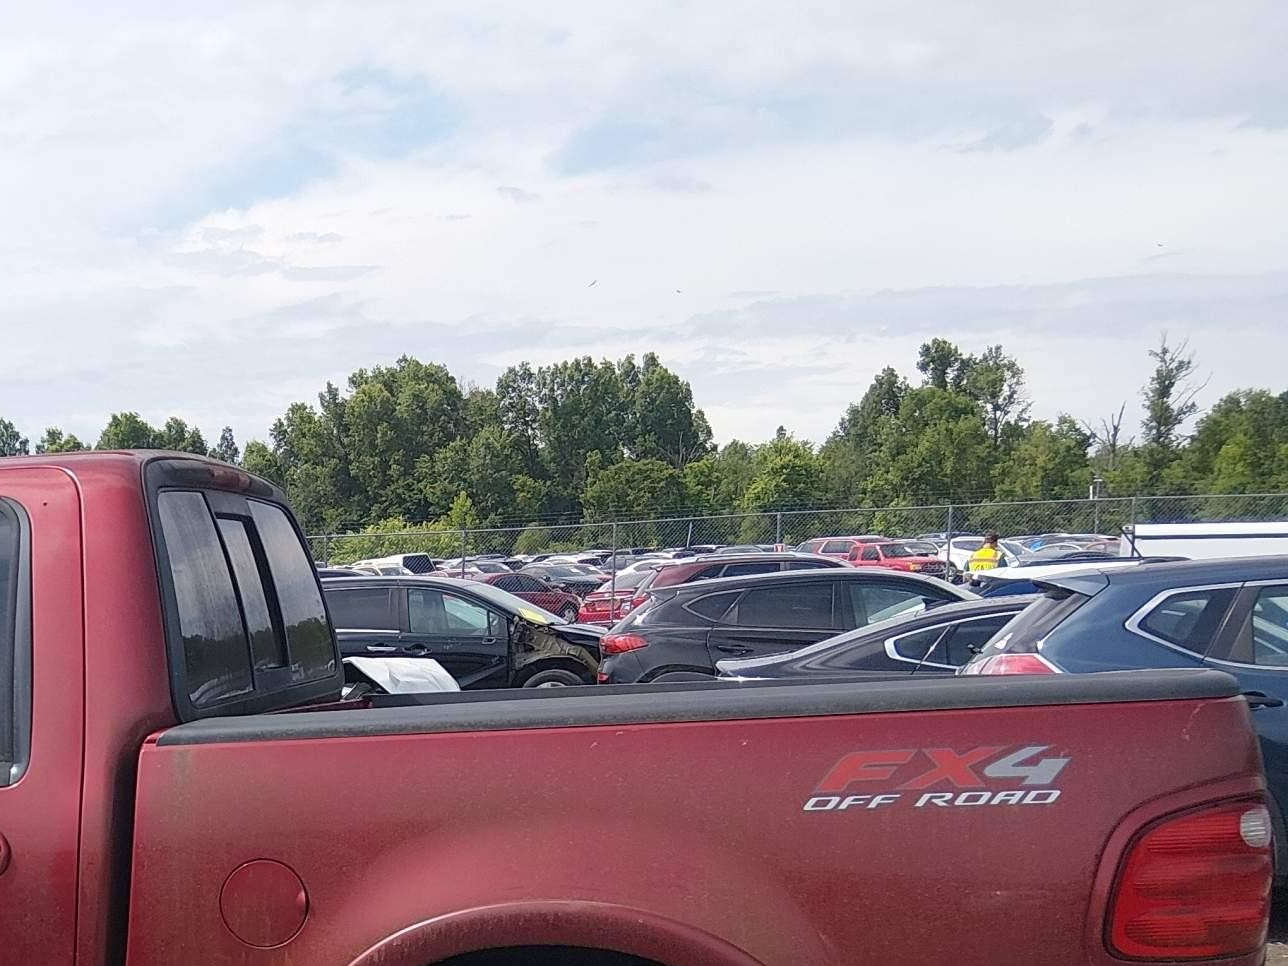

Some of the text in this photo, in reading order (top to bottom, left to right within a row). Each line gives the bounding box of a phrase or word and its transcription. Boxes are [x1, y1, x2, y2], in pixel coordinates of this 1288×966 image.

[813, 745, 1071, 792] FX4
[802, 789, 1062, 811] OFF ROAD
